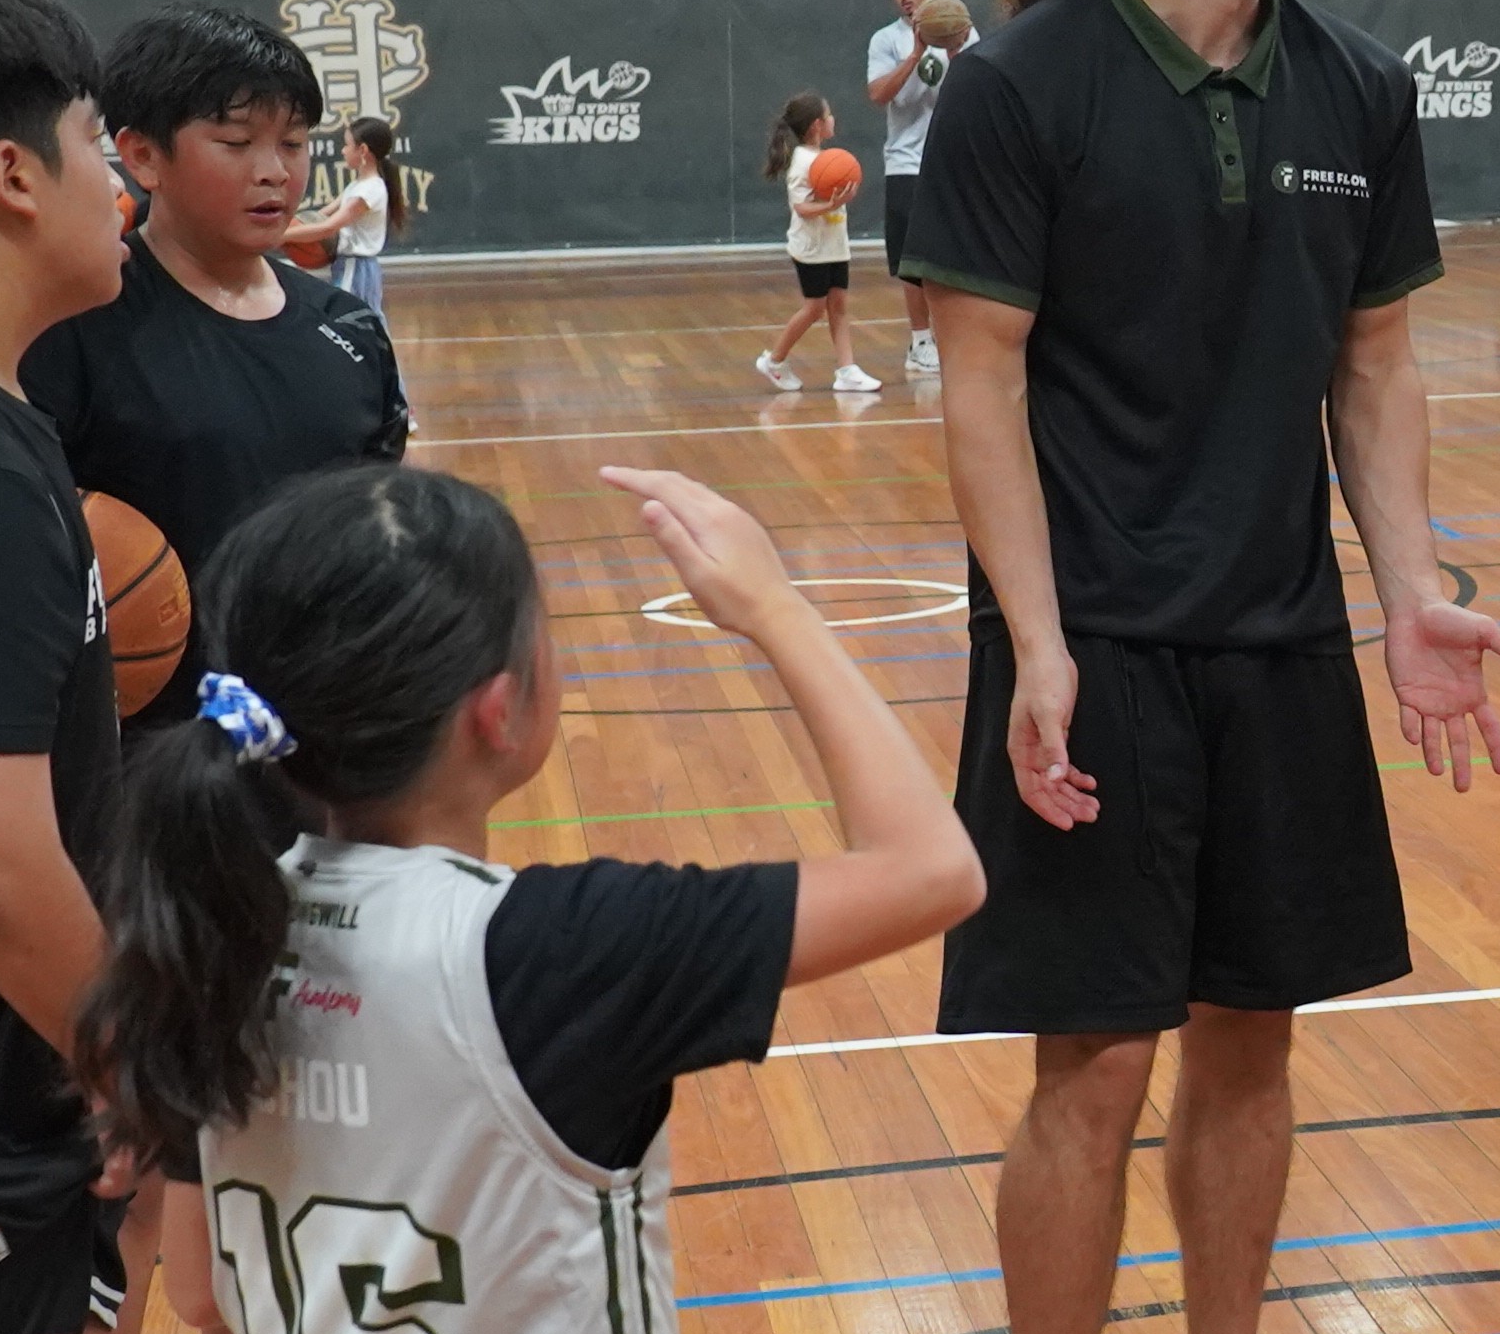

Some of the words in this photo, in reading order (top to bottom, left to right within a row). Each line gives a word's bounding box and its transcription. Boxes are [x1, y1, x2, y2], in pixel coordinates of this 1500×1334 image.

[1435, 80, 1493, 93] SYDNEY
[576, 102, 641, 116] SYDNEY
[1417, 91, 1493, 119] INGS
[520, 113, 641, 144] KINGS
[1303, 169, 1335, 183] FREE
[1303, 183, 1370, 199] BASKETBALL
